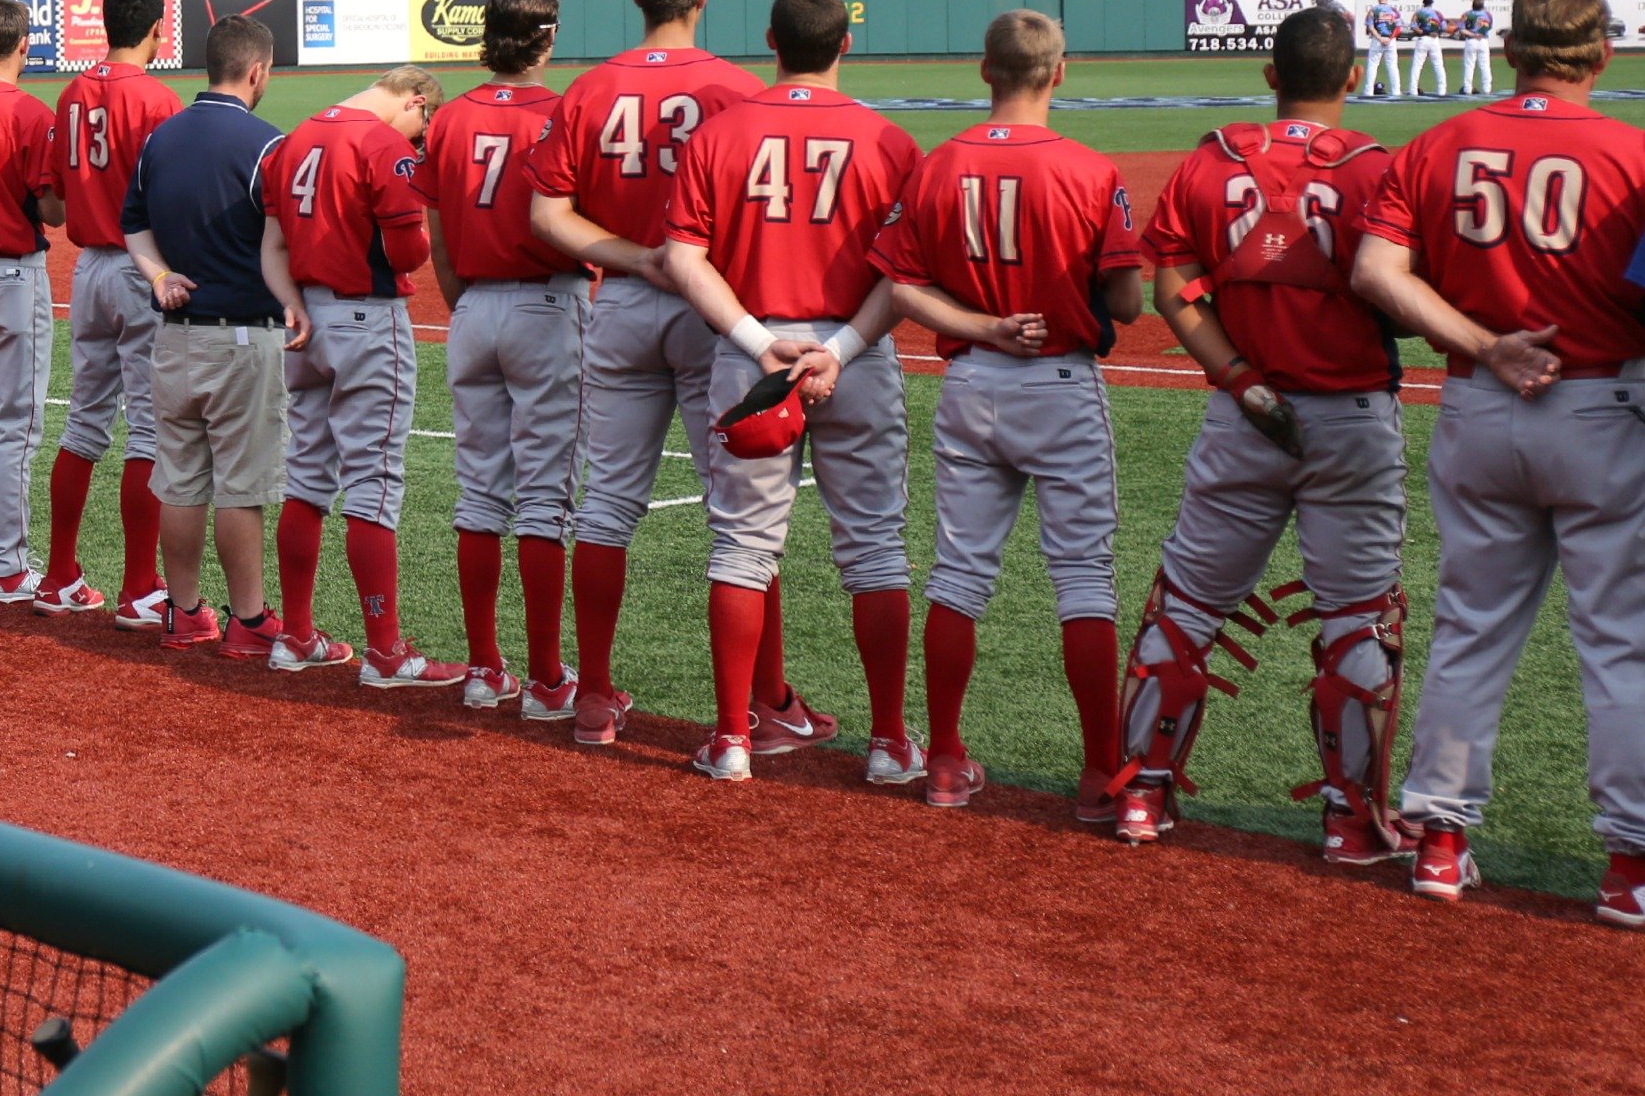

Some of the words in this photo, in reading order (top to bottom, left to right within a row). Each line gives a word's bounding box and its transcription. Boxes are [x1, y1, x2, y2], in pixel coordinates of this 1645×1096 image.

[305, 5, 333, 15] HOSPITAL
[305, 15, 318, 23] FOR
[29, 28, 52, 45] ank
[305, 24, 330, 33] SPECIAL
[437, 27, 466, 36] SUPPLY
[1187, 22, 1245, 36] Avengers
[305, 33, 333, 42] SURGERY
[425, 51, 460, 60] BUILDING
[67, 101, 111, 172] 13
[598, 92, 705, 180] 43
[472, 131, 512, 209] 7
[290, 145, 326, 218] 4
[745, 134, 855, 226] 47
[1453, 146, 1590, 255] 50
[959, 173, 1023, 265] 11
